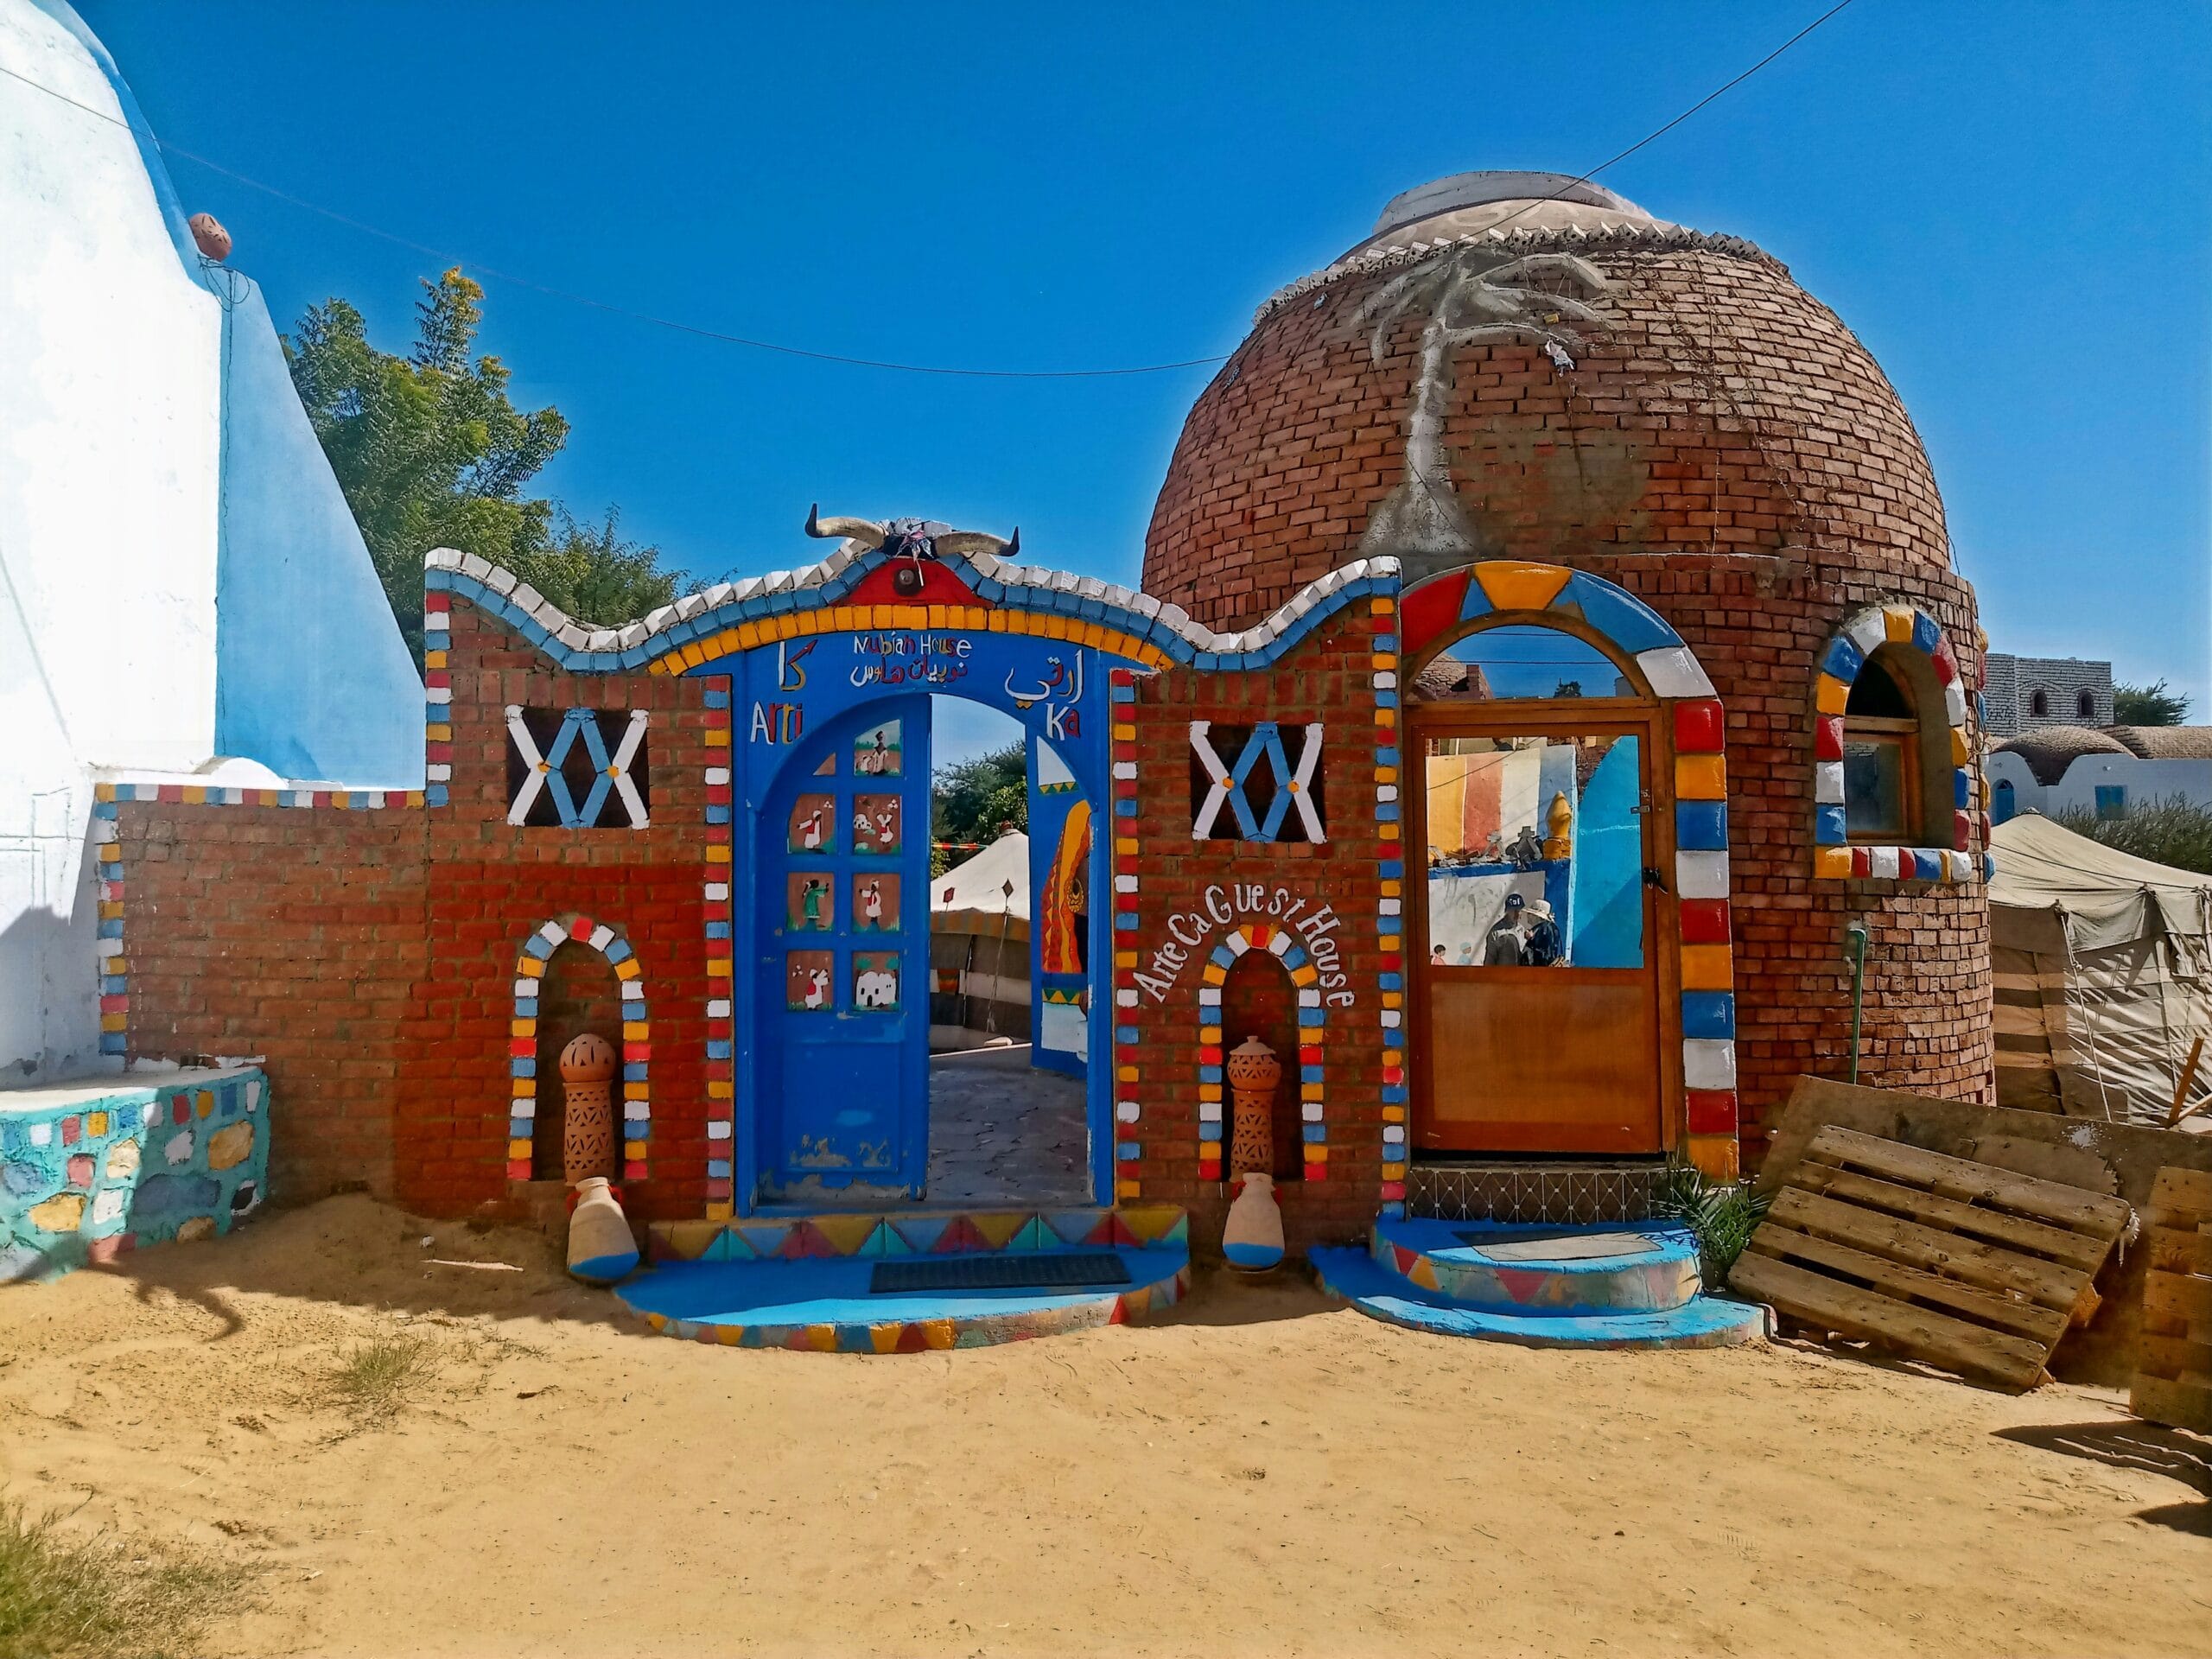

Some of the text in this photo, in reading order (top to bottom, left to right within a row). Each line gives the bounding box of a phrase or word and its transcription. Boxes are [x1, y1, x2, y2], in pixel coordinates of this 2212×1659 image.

[853, 631, 973, 658] Nubian House
[750, 701, 1080, 745] Arti Ka
[1205, 883, 1306, 924] Guest
[1295, 903, 1355, 1007] House
